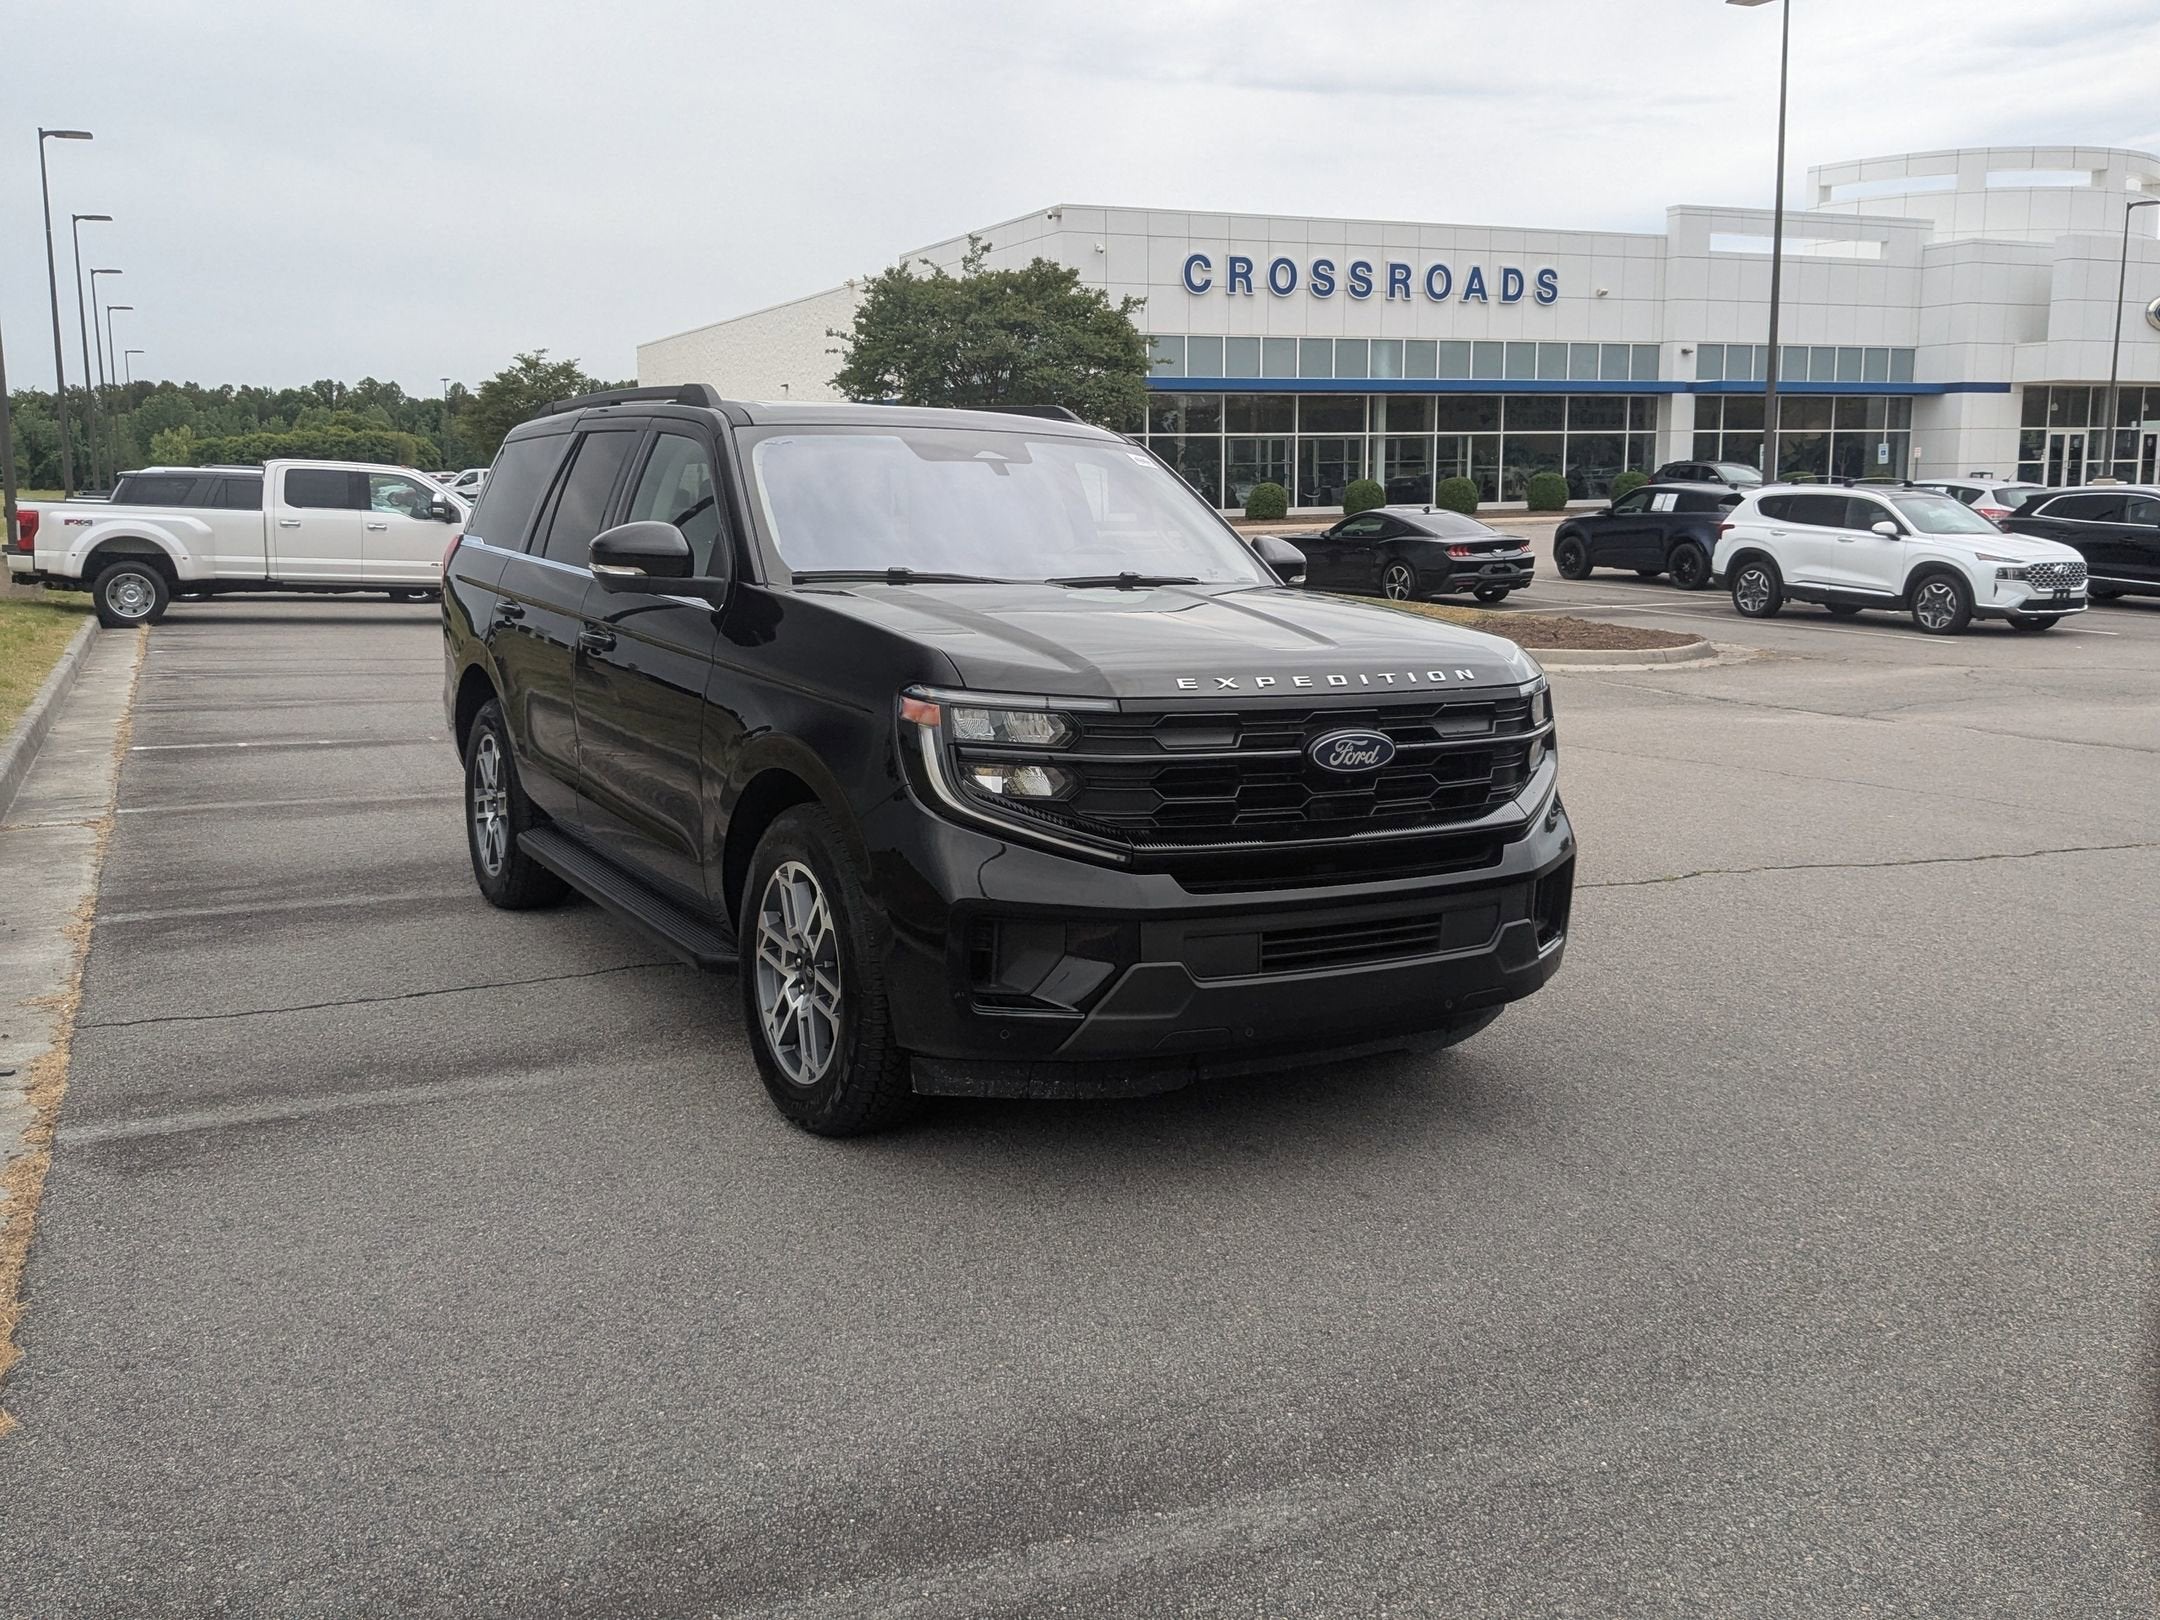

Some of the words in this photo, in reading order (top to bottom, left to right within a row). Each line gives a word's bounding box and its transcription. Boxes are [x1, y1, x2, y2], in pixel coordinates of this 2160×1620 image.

[1182, 253, 1560, 306] CROSSROADS
[1176, 668, 1476, 690] EXPEDITION
[1329, 739, 1381, 766] Ford
